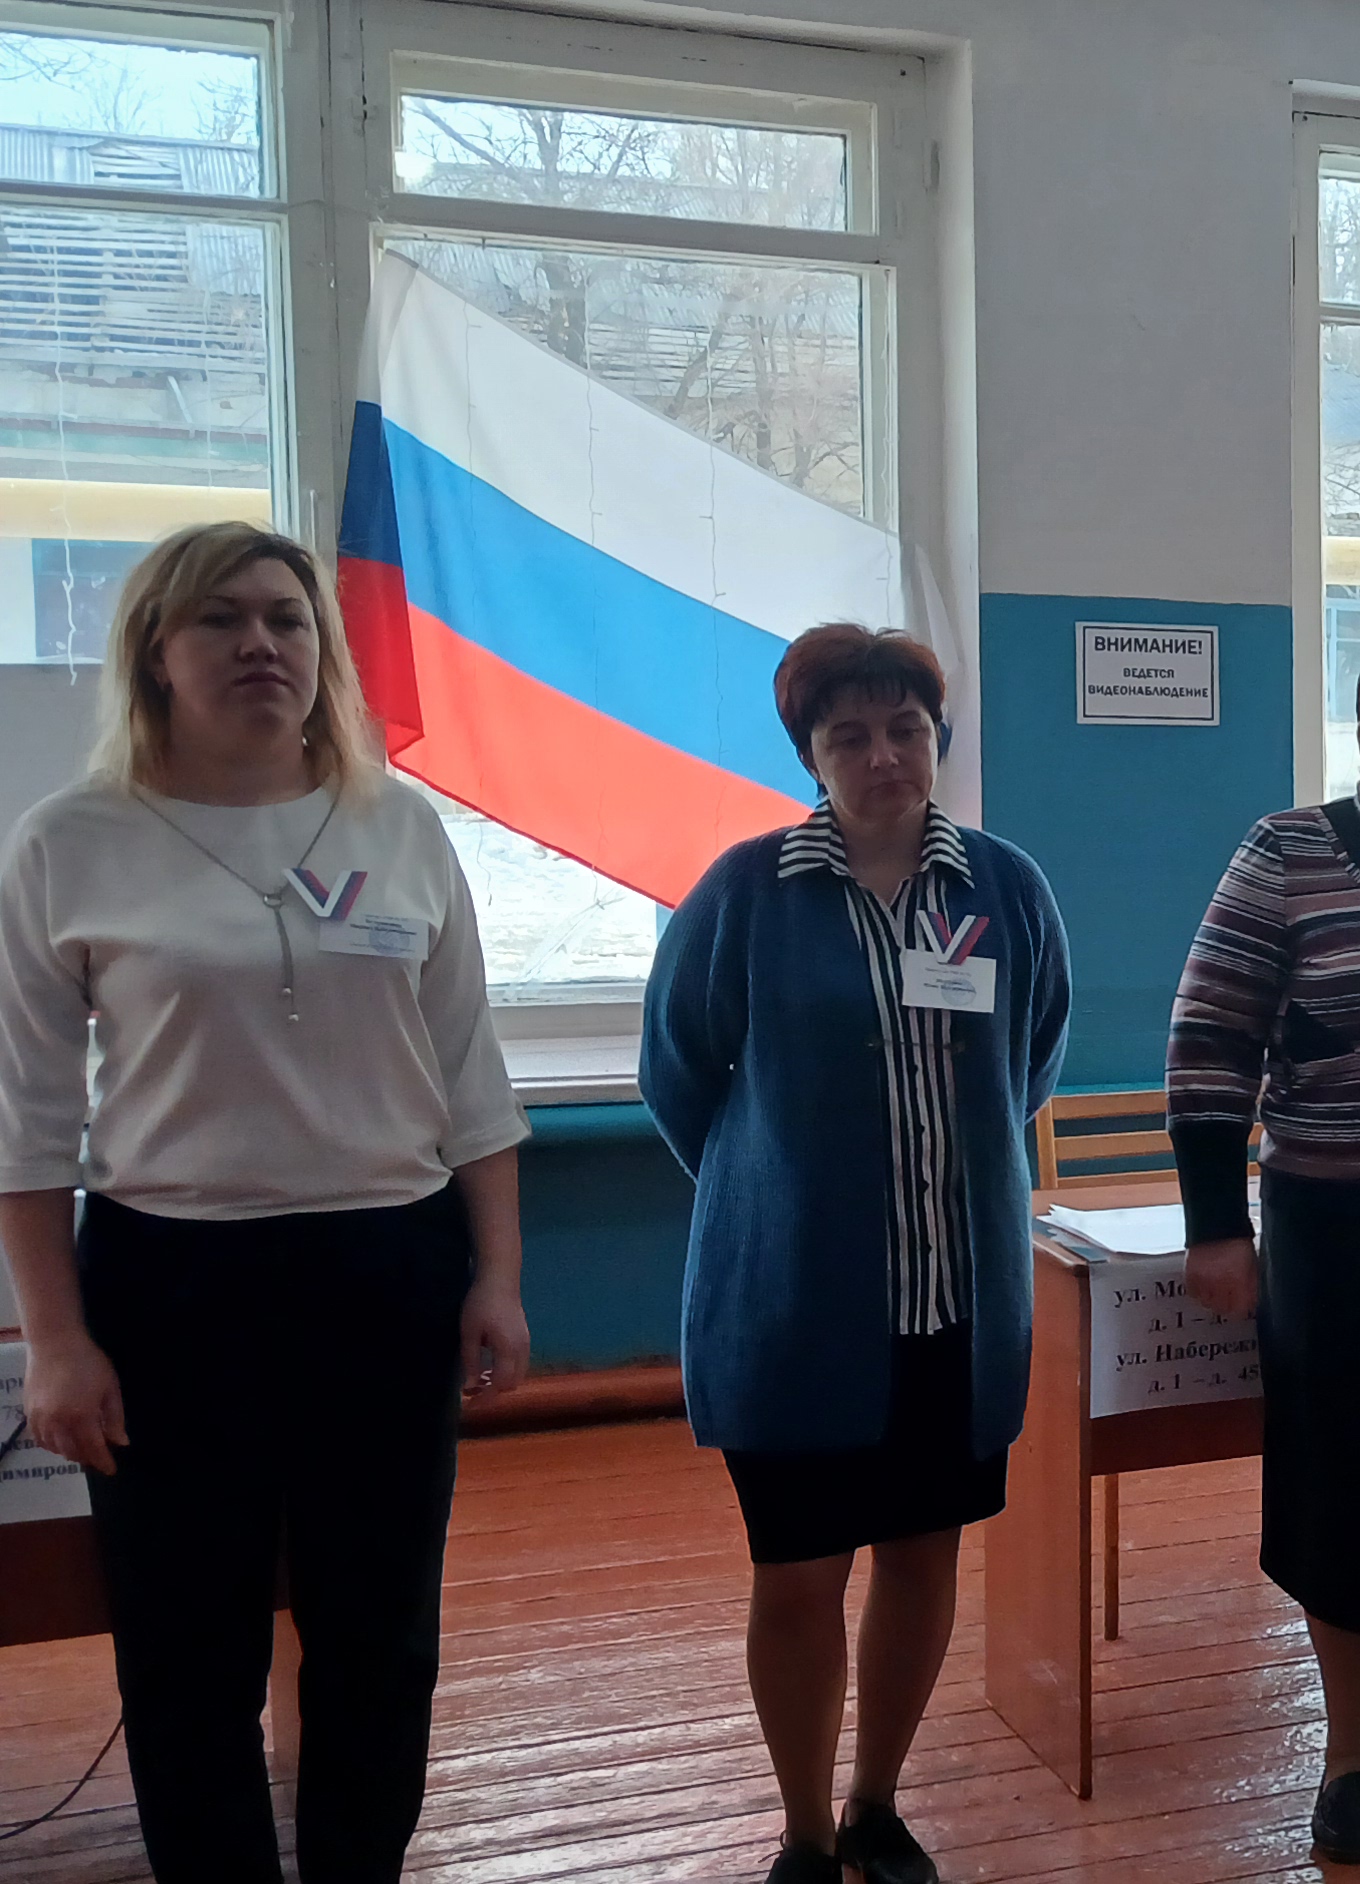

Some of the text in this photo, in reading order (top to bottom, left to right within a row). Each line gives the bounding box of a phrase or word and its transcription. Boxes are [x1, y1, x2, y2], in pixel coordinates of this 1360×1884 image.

[1094, 636, 1203, 655] ВНИМАНИЕ!
[1123, 667, 1175, 680] ВЕДЕТСЯ
[1088, 685, 1209, 699] ВИДЕОНАБЛЮДЕНИЕ
[1113, 1280, 1187, 1308] ул. Мо
[1148, 1317, 1167, 1333] д.
[1175, 1312, 1183, 1328] 1
[1116, 1338, 1257, 1372] ул. Набереж
[1147, 1379, 1165, 1394] д.
[1173, 1374, 1181, 1389] 1
[1208, 1371, 1227, 1386] д.
